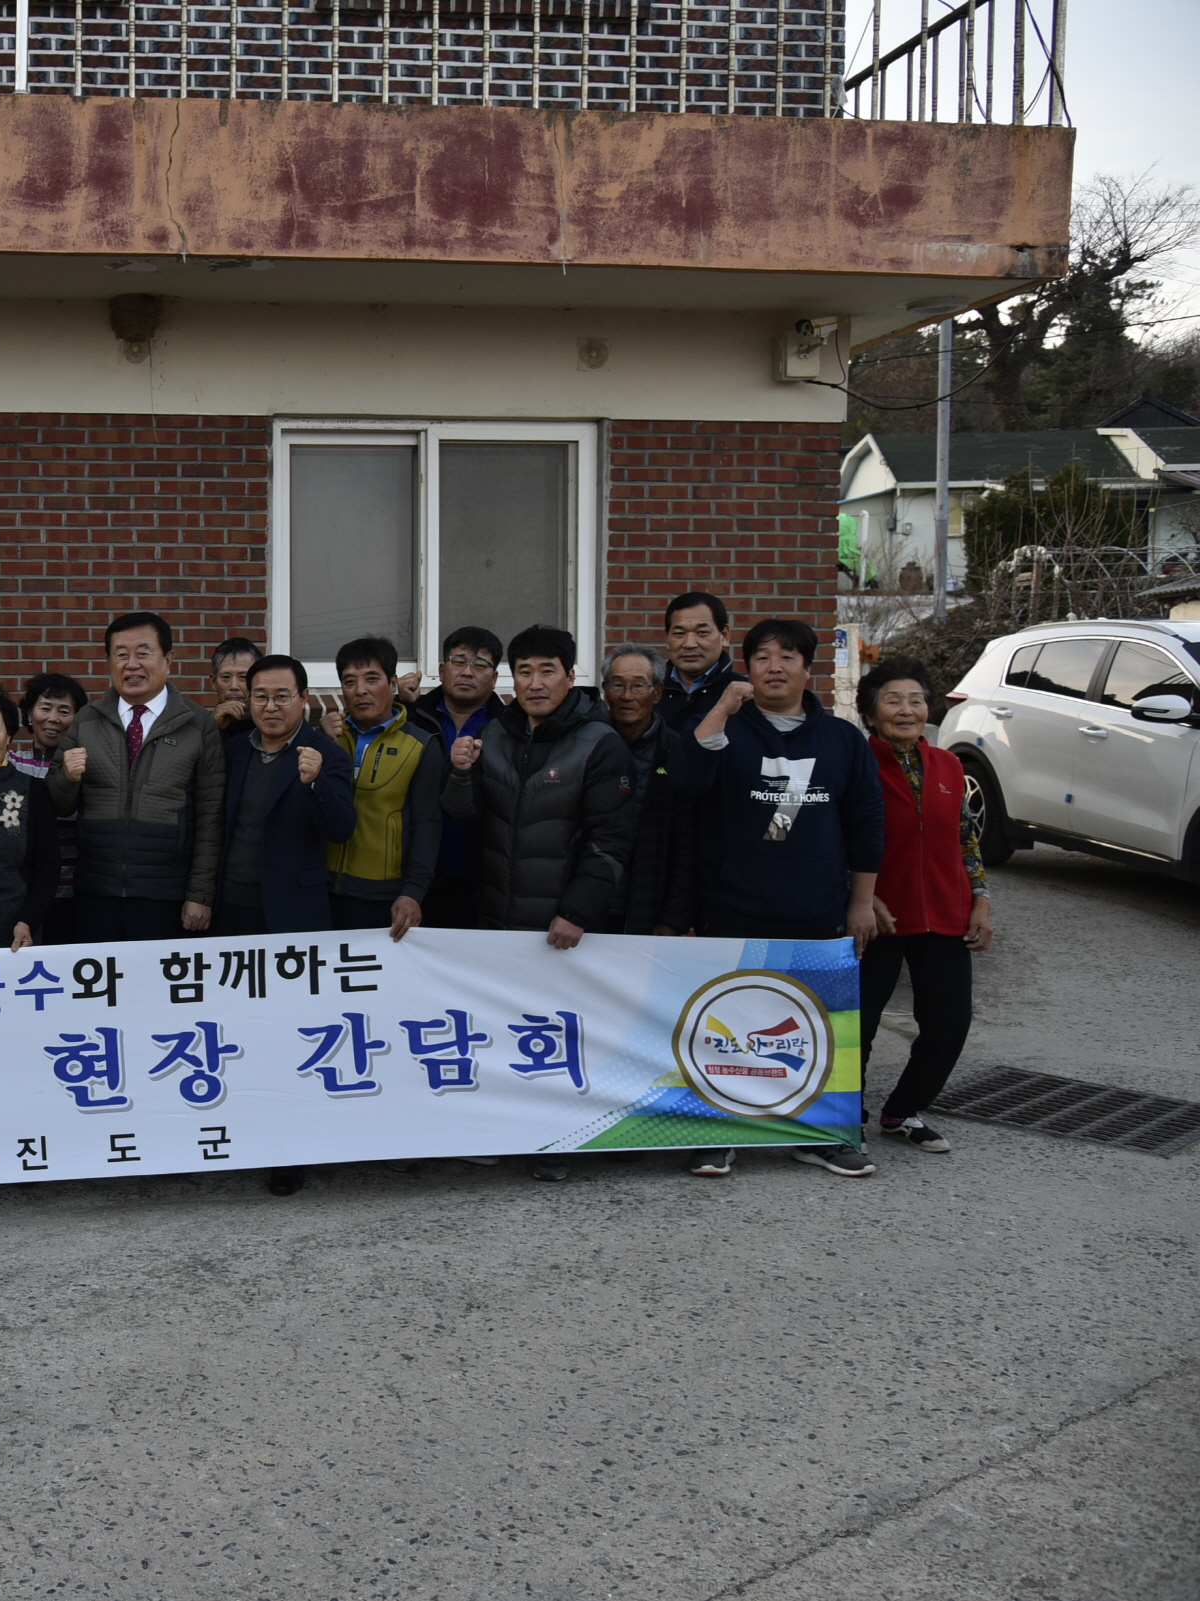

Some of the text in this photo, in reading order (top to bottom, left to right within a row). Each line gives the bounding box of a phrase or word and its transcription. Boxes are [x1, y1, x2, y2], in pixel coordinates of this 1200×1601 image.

[164, 737, 177, 746] K2
[159, 943, 384, 1004] 함께하는
[43, 1020, 242, 1110] 현장
[296, 1009, 586, 1093] 간담회
